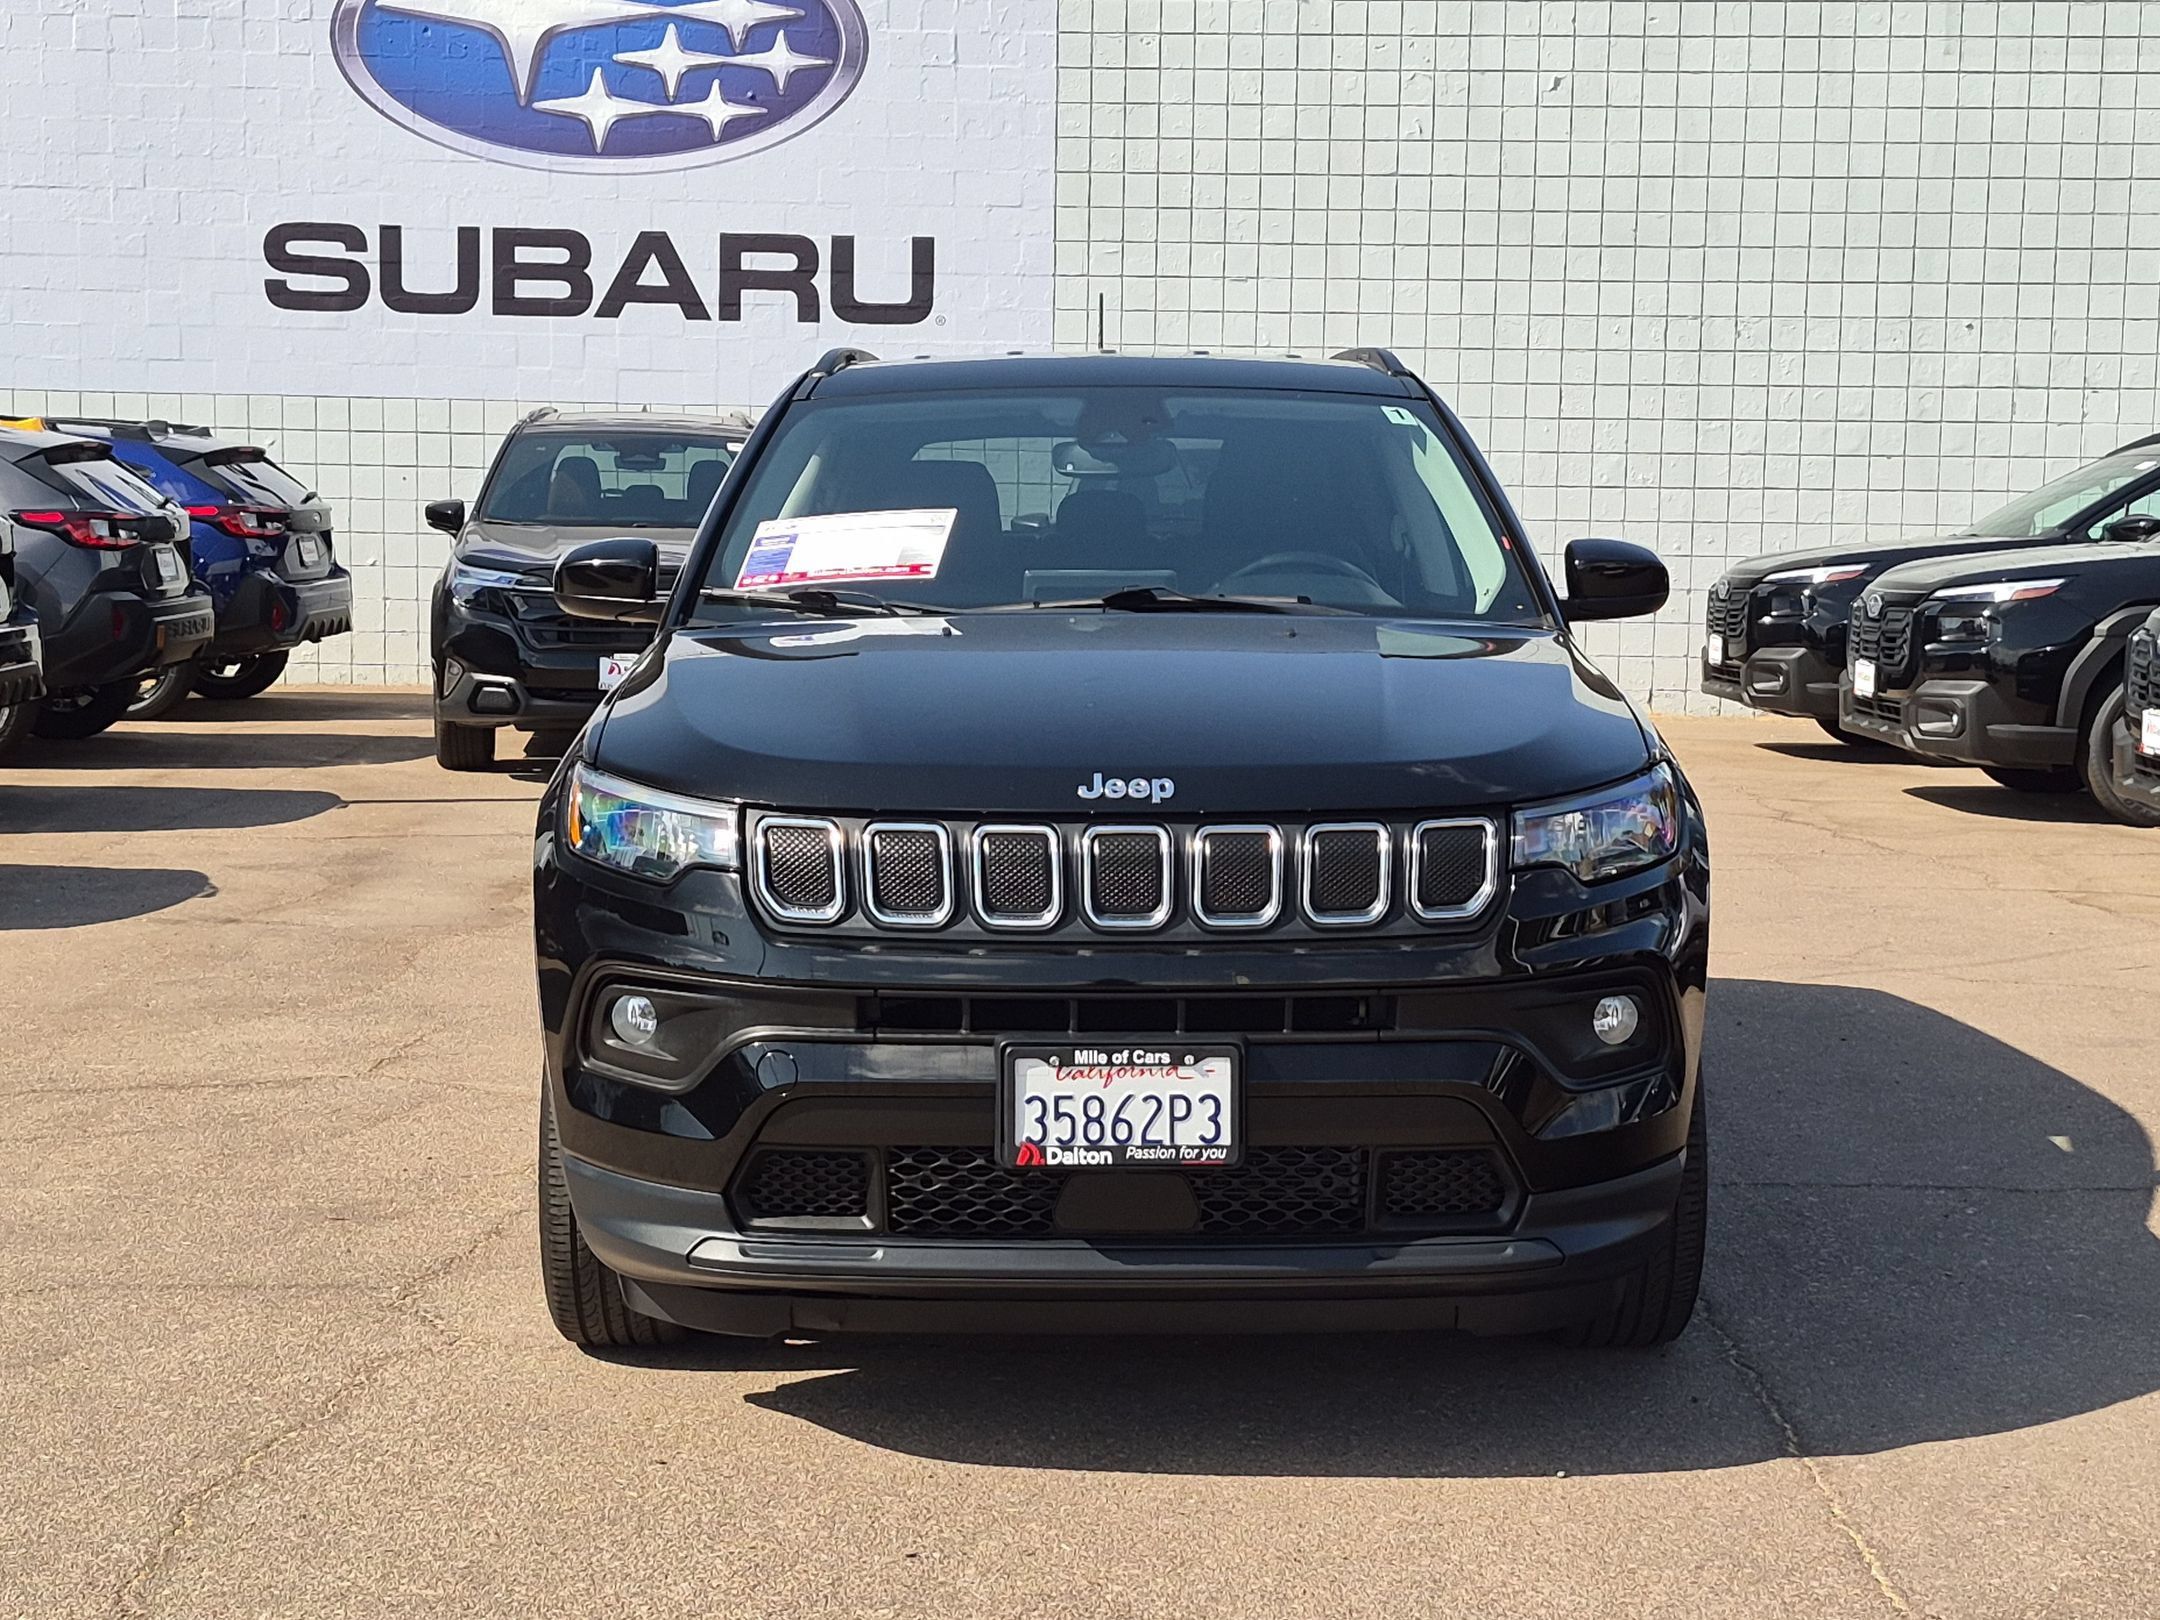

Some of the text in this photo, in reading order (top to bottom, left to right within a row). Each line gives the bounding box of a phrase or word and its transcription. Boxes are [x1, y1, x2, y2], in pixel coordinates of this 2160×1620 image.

[263, 222, 935, 325] SUBARU
[1077, 772, 1175, 803] Jeep
[1074, 1050, 1171, 1065] Mile of Cars
[1024, 1094, 1222, 1146] 35862P3
[1046, 1146, 1113, 1165] Dalton
[1126, 1146, 1227, 1161] Passion for you
